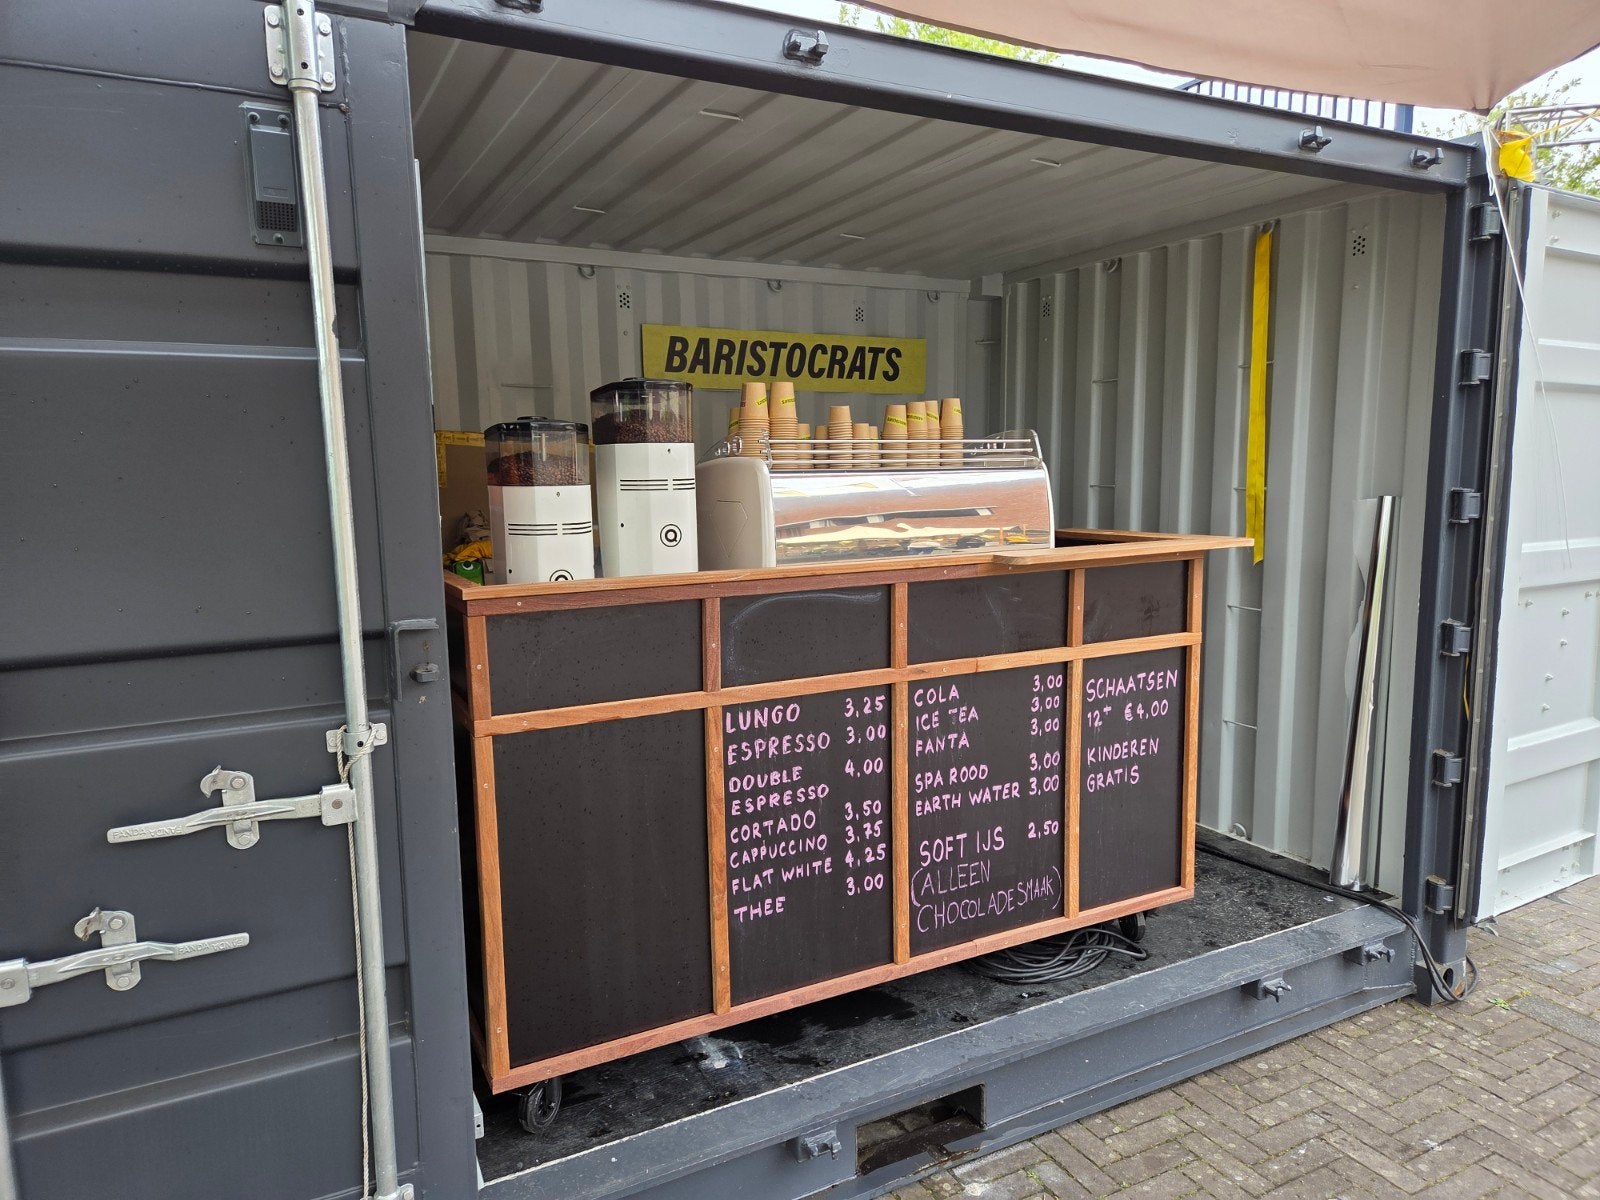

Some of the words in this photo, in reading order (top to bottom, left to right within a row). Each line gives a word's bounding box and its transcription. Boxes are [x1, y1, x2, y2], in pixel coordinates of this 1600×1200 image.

[664, 335, 902, 381] BARISTOCRATS
[914, 684, 959, 707] COLA
[1033, 675, 1062, 692] 3,00
[1086, 669, 1178, 702] SCHAATSEN
[726, 703, 800, 734] LUNGO
[844, 695, 886, 718] 3,25
[916, 710, 939, 731] ICE
[1031, 696, 1059, 712] 3,00
[727, 731, 830, 766] ESPRESSO
[846, 724, 886, 744] 3,00
[916, 731, 970, 757] FANTA
[1030, 718, 1060, 736] 3,00
[1087, 738, 1159, 765] KINDEREN
[729, 766, 803, 793] DOUBLE
[845, 757, 883, 777] 4,00
[915, 770, 943, 793] SPA
[949, 764, 988, 785] ROOD
[1029, 751, 1060, 771] 3,00
[1087, 764, 1140, 792] GRATIS
[731, 783, 829, 816] ESPRESSO
[916, 793, 961, 816] EARTH
[969, 781, 1020, 806] WATER
[1028, 775, 1059, 795] 3,00
[730, 809, 816, 844] CORTADO
[845, 800, 882, 820] 3,50
[730, 834, 828, 869] CAPPUCCINO
[845, 820, 883, 844] 3,75
[920, 833, 968, 867] SOFT
[976, 826, 1005, 853] IJS
[1028, 820, 1059, 839] 2,50
[732, 868, 774, 895] FLAT
[782, 857, 833, 883] WHITE
[845, 843, 886, 867] 4,25
[734, 897, 785, 922] THEE
[846, 874, 884, 896] 3,00
